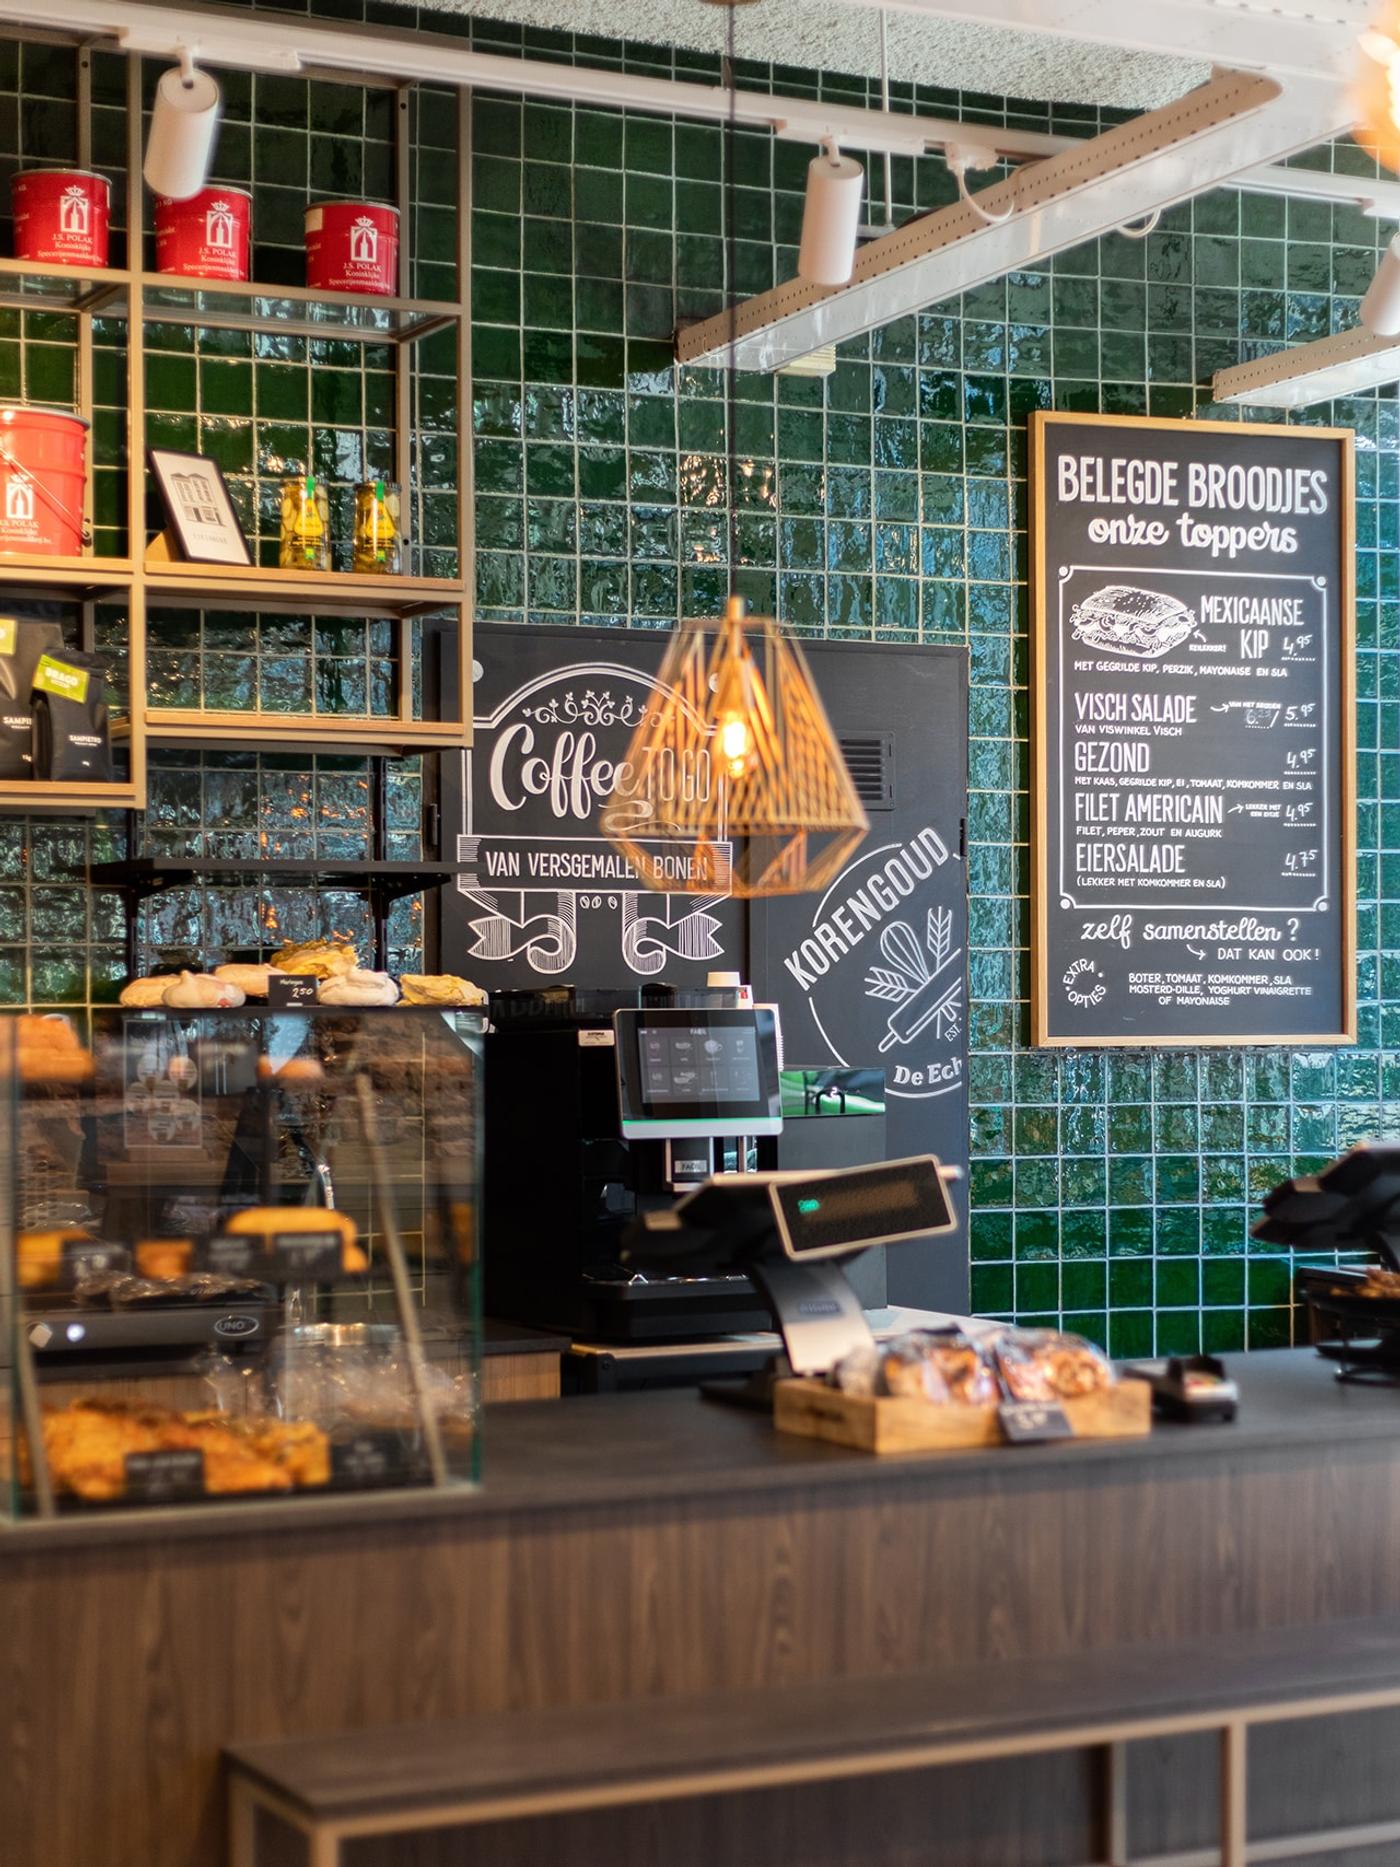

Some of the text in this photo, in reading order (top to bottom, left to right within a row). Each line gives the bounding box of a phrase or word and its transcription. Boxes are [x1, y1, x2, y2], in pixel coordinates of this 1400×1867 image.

[67, 235, 92, 244] POLAK
[212, 248, 236, 257] POLAK
[357, 263, 382, 272] POLAK
[1058, 455, 1328, 514] BELEGDE BROODJES
[1088, 512, 1298, 557] onze toppers
[1200, 595, 1304, 626] MEXICAANSE
[1240, 630, 1268, 659] KIP
[1074, 661, 1093, 671] MET
[1096, 662, 1140, 672] GEGRILDE
[1200, 665, 1251, 676] MAYONAISE
[1256, 667, 1269, 676] EN
[1271, 667, 1287, 677] SLA
[1075, 693, 1196, 724] VISCH SALADE
[1075, 724, 1096, 734] VAN
[1099, 725, 1151, 736] VISWINKEL
[1075, 741, 1149, 773] GEZOND
[1286, 749, 1316, 769] 4.95
[490, 723, 642, 820] Coffee
[1075, 777, 1092, 785] MET
[1119, 777, 1157, 787] GEGRILDE
[1227, 780, 1279, 790] KOMKOMMER
[1283, 781, 1294, 790] EN
[1295, 782, 1312, 791] SLA
[1075, 793, 1223, 824] FILET AMERICAIN
[1286, 803, 1313, 821] 4.95
[1140, 828, 1165, 837] ZOUT
[1170, 829, 1182, 837] EN
[1185, 829, 1222, 838] AUGURK
[486, 852, 707, 881] VAN VERSGEMALEN BONEN
[1077, 844, 1185, 873] EIERSALADE
[1076, 877, 1225, 889] (LEKKER MET KOMKOMMER EN SLA)
[784, 827, 949, 991] KORENGOUD
[1081, 915, 1133, 950] zelf
[1143, 918, 1281, 942] samenstellen
[1217, 948, 1243, 960] DAT
[1248, 949, 1275, 960] KAN
[1063, 958, 1095, 986] EXTRA
[1273, 976, 1292, 985] SLA
[1067, 984, 1107, 1008] OPTIES
[1208, 985, 1251, 995] YOGHURT
[1253, 986, 1311, 996] VINAIGRETTE
[1158, 996, 1230, 1006] OF MAYONAISE
[894, 1065, 922, 1085] De
